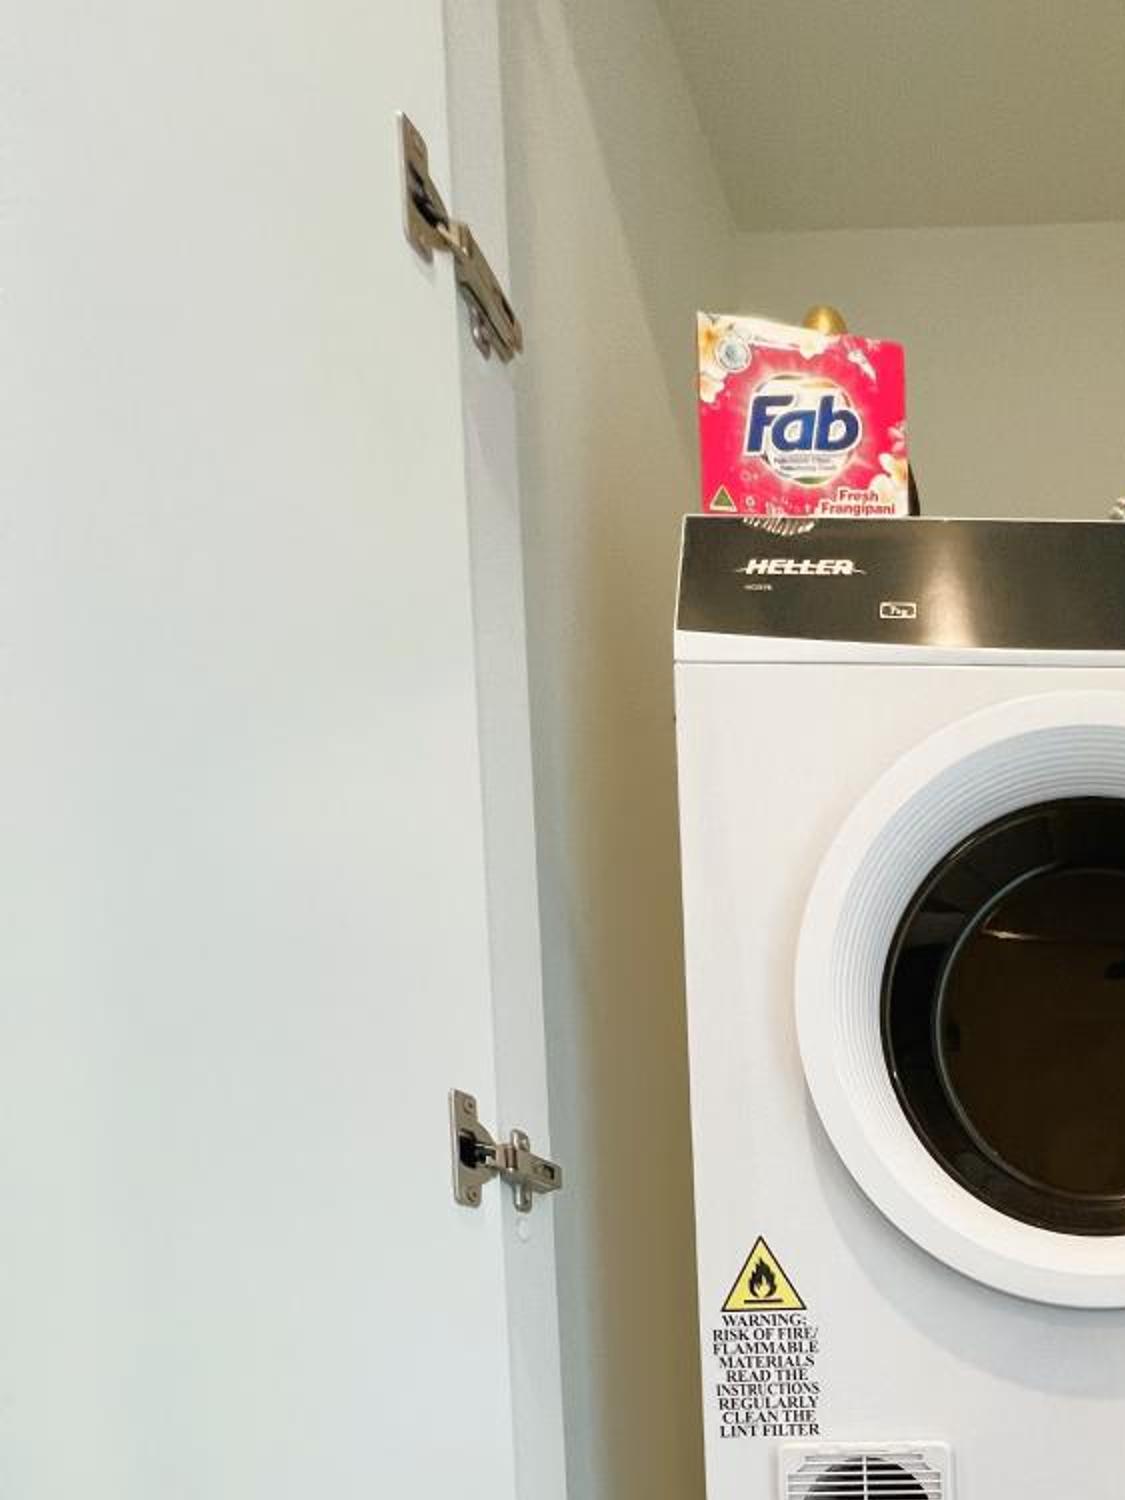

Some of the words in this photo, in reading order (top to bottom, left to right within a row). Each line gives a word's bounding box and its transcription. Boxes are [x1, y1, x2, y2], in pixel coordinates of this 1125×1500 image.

[745, 394, 861, 454] Fab
[839, 489, 879, 502] Fresh
[821, 502, 896, 517] Frangipani
[745, 559, 854, 575] HELLER
[722, 1314, 808, 1327] WARNING:
[713, 1329, 749, 1342] RISK
[754, 1329, 774, 1341] OF
[713, 1341, 820, 1356] FLAMMABLE
[719, 1355, 815, 1369] MATERIALS
[726, 1370, 771, 1383] READ
[775, 1369, 809, 1381] THE
[717, 1382, 820, 1397] INSTRUCTIONS
[719, 1396, 819, 1410] REGULARLY
[723, 1411, 779, 1424] CLEAN
[782, 1410, 816, 1423] THE
[720, 1425, 758, 1439] LINT
[763, 1424, 820, 1438] FILTER
